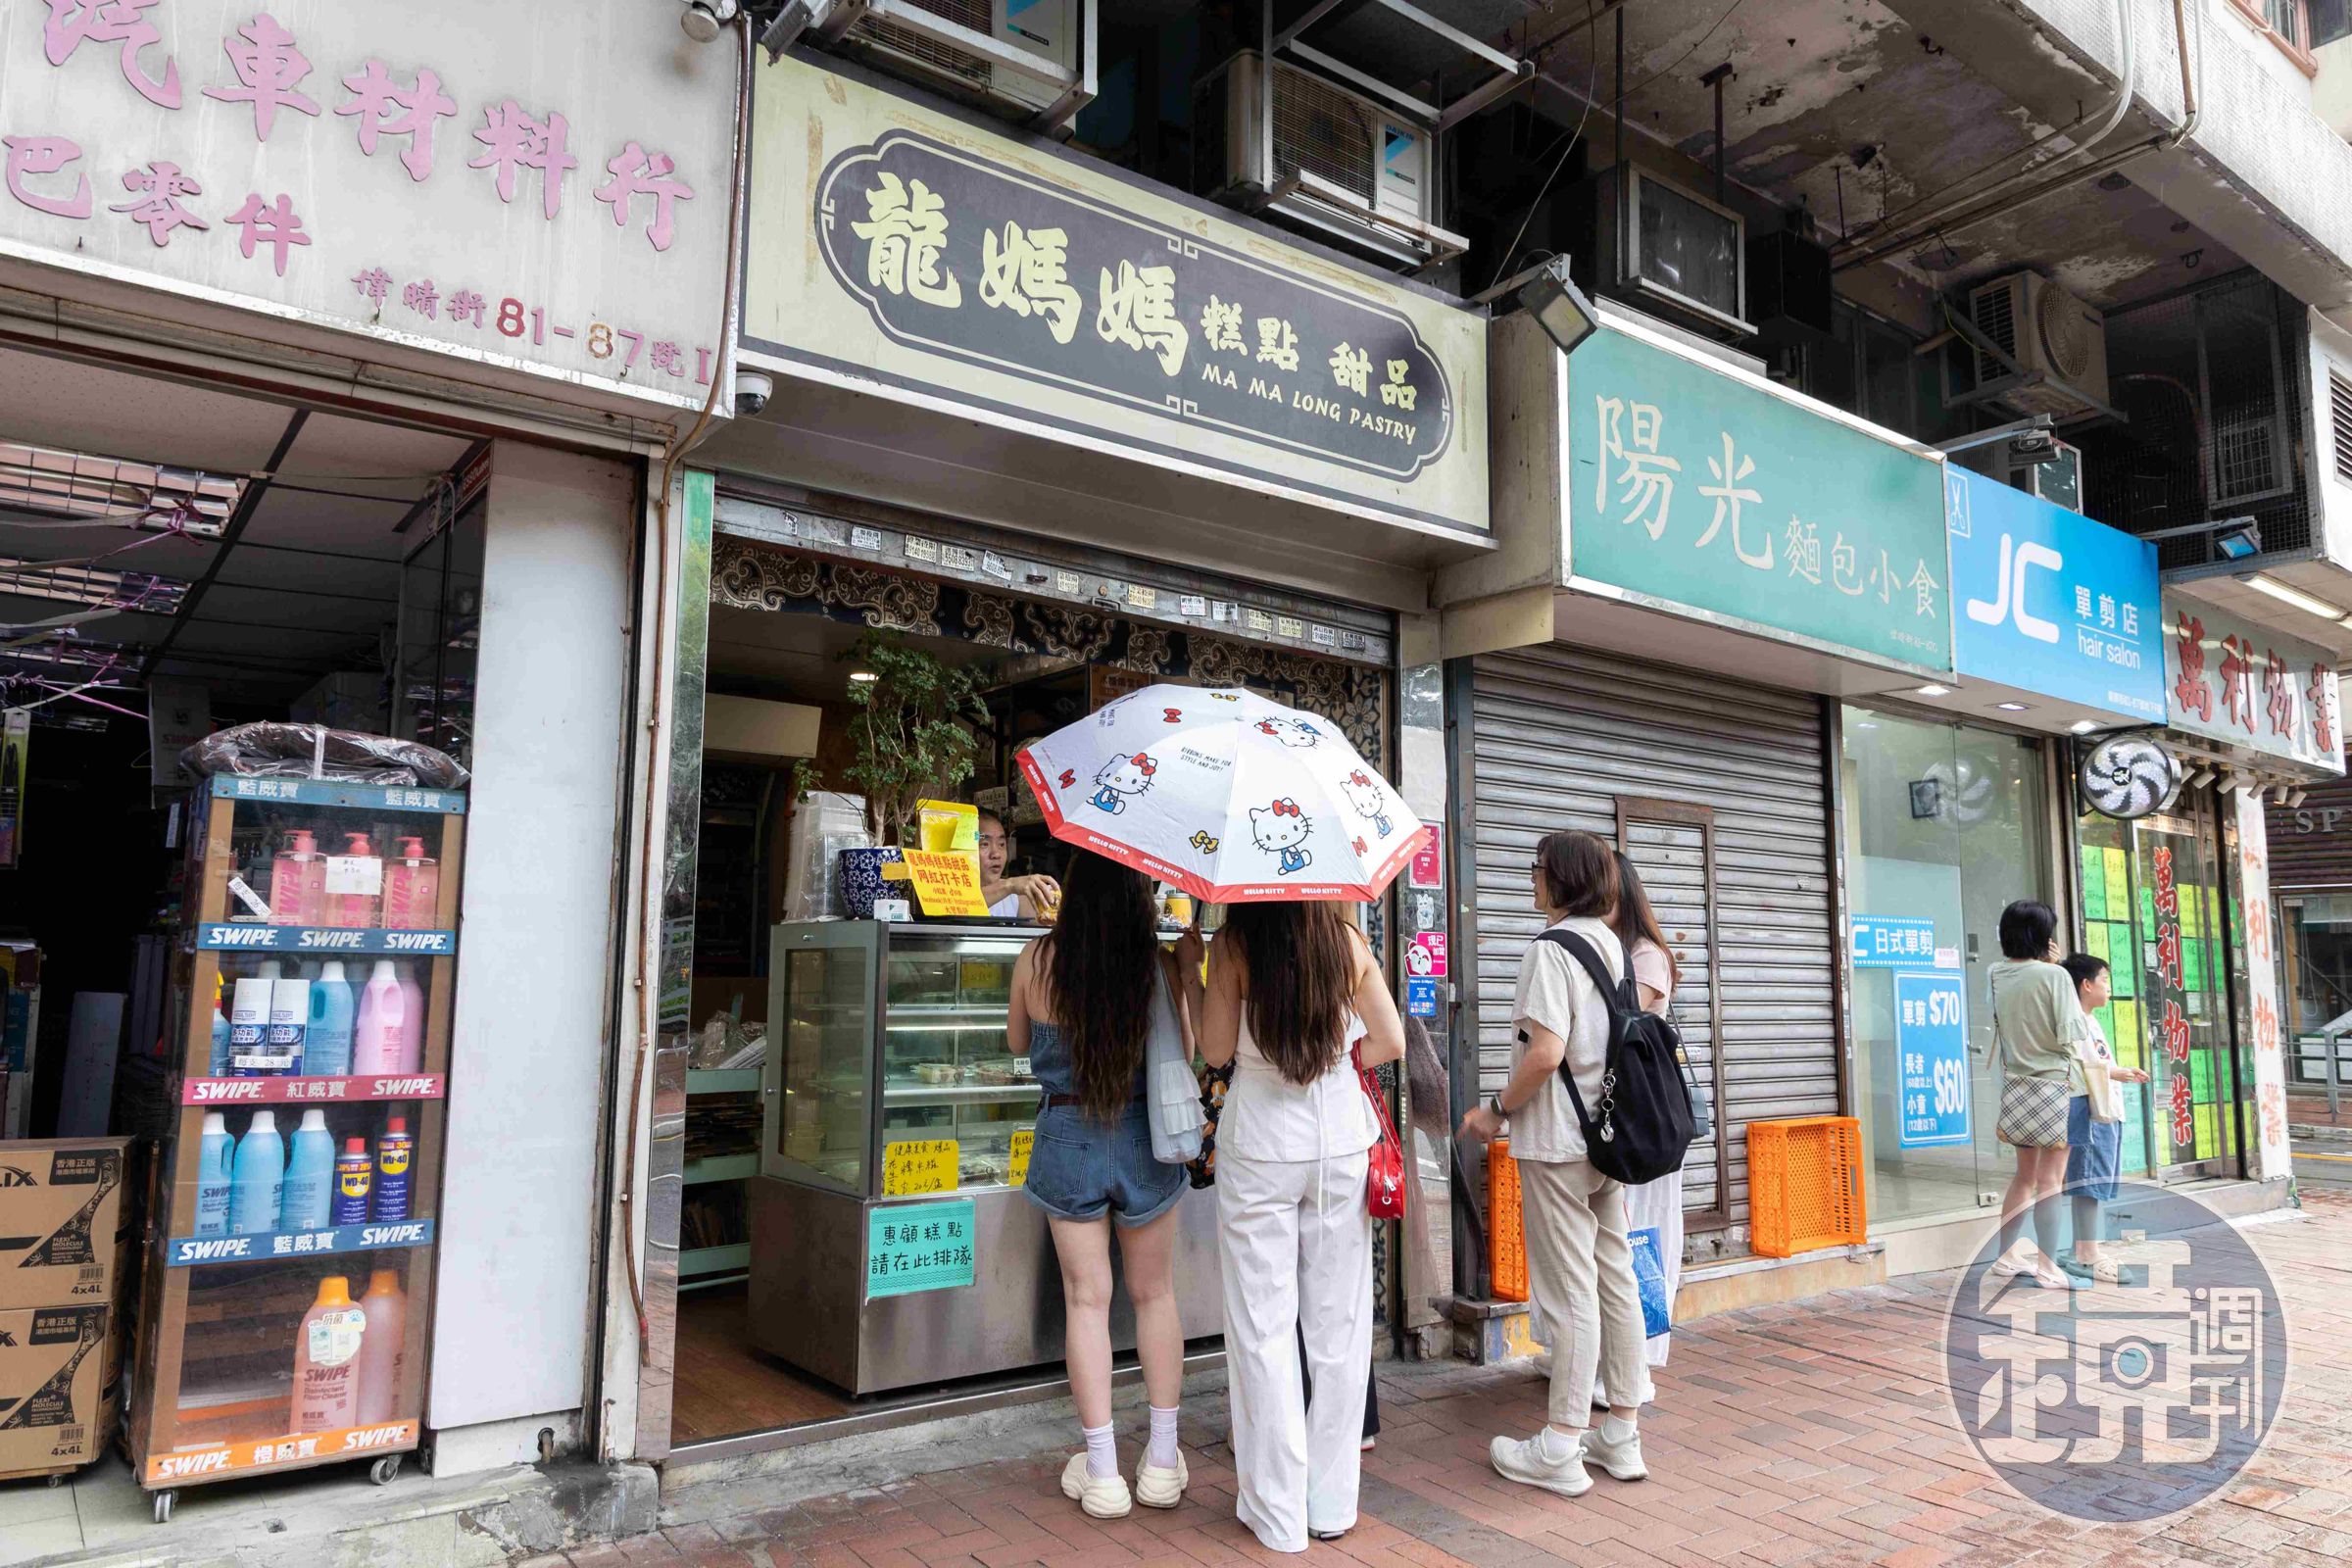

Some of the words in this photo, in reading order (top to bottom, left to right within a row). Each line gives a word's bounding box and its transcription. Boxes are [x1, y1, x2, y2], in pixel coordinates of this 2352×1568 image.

[1329, 342, 1417, 411] 甜品
[1201, 364, 1238, 389] MA
[1249, 377, 1283, 404] MA
[1292, 390, 1341, 422] LONG
[1348, 407, 1416, 445] PASTRY
[1595, 394, 1774, 570] 陽光
[1967, 533, 2063, 644] JC
[2075, 585, 2139, 636] 單剪店
[2078, 628, 2104, 659] hair
[2106, 643, 2140, 670] salon
[2175, 611, 2336, 753] 萬利物業
[1180, 755, 1197, 765] STYLE
[1198, 760, 1208, 770] AND
[1204, 755, 1219, 764] MAKE
[2295, 808, 2352, 834] SP
[1088, 835, 1108, 848] HELLO
[1107, 842, 1129, 856] KITTY
[1142, 858, 1163, 870] HELLO
[1162, 865, 1184, 879] KITTY
[209, 928, 276, 946] SWIPE
[298, 931, 363, 948] SWIPE
[384, 933, 445, 950] SWIPE
[1876, 928, 1934, 956] 日式單剪
[1903, 1000, 1927, 1026] 單剪
[1929, 989, 1960, 1026] $70
[2153, 846, 2194, 1147] 萬利物業
[1905, 1054, 1926, 1075] 長者
[193, 1083, 264, 1100] SWIPE
[371, 1079, 435, 1096] SWIPE
[1935, 1056, 1965, 1117] $60
[1907, 1095, 1927, 1115] 小童
[0, 1170, 37, 1188] IX
[345, 1178, 368, 1187] WD-40
[360, 1223, 424, 1246] SWIPE
[883, 1222, 962, 1247] 惠顧糕點
[178, 1239, 250, 1260] SWIPE
[870, 1245, 973, 1275] 請在此排隊
[304, 1365, 351, 1382] SWIPE
[344, 1425, 408, 1450] SWIPE
[158, 1449, 231, 1477] SWIPE
